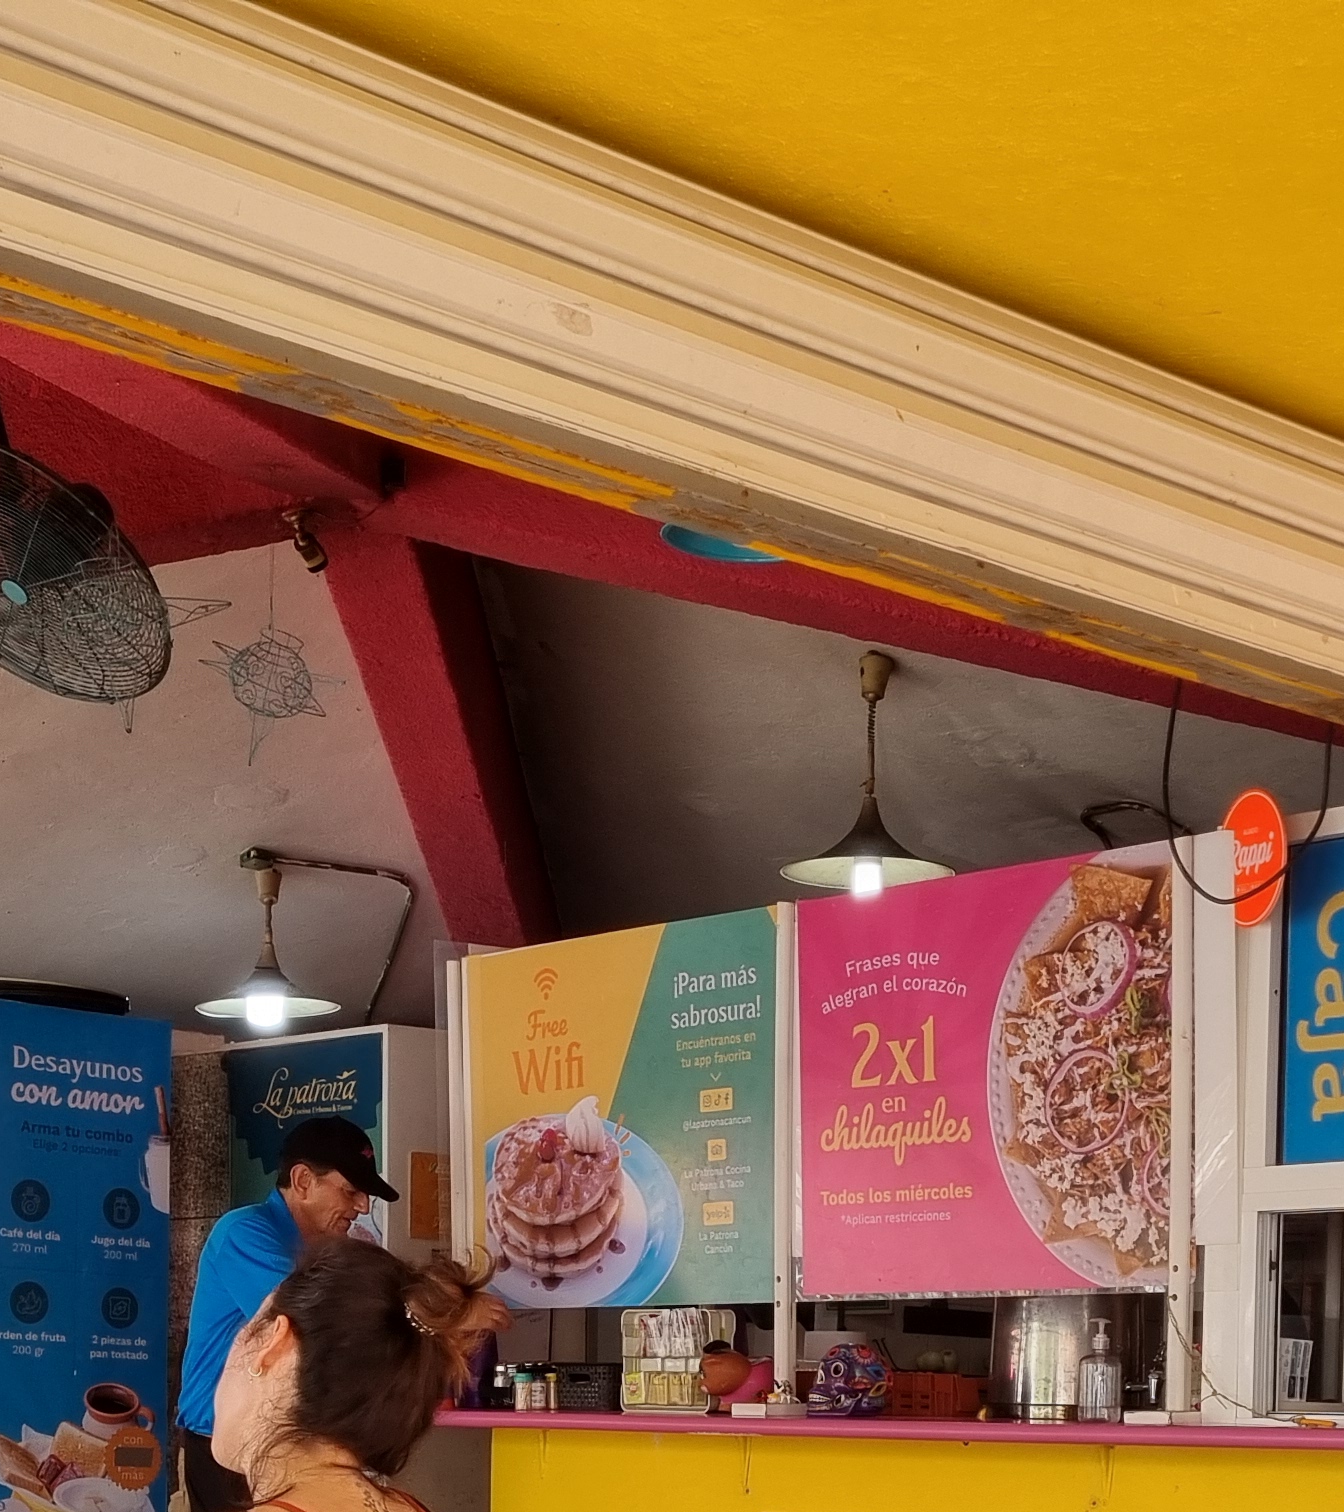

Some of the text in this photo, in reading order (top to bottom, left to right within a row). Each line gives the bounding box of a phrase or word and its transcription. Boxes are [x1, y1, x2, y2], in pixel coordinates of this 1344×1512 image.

[845, 952, 940, 977] Frases que
[673, 964, 757, 999] ¡Para más
[821, 975, 967, 1015] alegran el corazón
[670, 994, 761, 1029] sabrosura!
[526, 1009, 569, 1041] Free
[676, 1032, 756, 1051] Encuéntranos en
[681, 1049, 752, 1068] tu app favorita
[851, 1015, 937, 1088] 2x1
[13, 1045, 143, 1083] Desayunos
[512, 1041, 584, 1095] Wifi
[11, 1082, 145, 1114] con amor
[253, 1067, 357, 1119] La patrona
[881, 1096, 906, 1113] en
[21, 1120, 133, 1143] Arma tu combo
[820, 1096, 972, 1166] chilaquiles
[33, 1139, 58, 1152] Elige
[62, 1142, 68, 1152] 2
[684, 1170, 693, 1179] La
[725, 1164, 751, 1175] Cocina
[727, 1178, 745, 1189] Taco
[820, 1182, 973, 1206] Todos los miércoles
[885, 1210, 951, 1223] restricciones
[0, 1227, 23, 1238] Café
[26, 1229, 42, 1239] del
[91, 1235, 115, 1247] Jugo
[118, 1236, 133, 1247] del
[698, 1229, 739, 1241] La Patrona
[12, 1243, 47, 1254] 270 ml
[104, 1250, 138, 1261] 200 ml
[704, 1243, 734, 1254] Cancún
[25, 1331, 38, 1341] de
[41, 1331, 66, 1342] fruta
[92, 1335, 147, 1347] 2 piezas de
[12, 1345, 45, 1357] 200 gr
[90, 1350, 149, 1360] pan tostado
[123, 1436, 143, 1445] con
